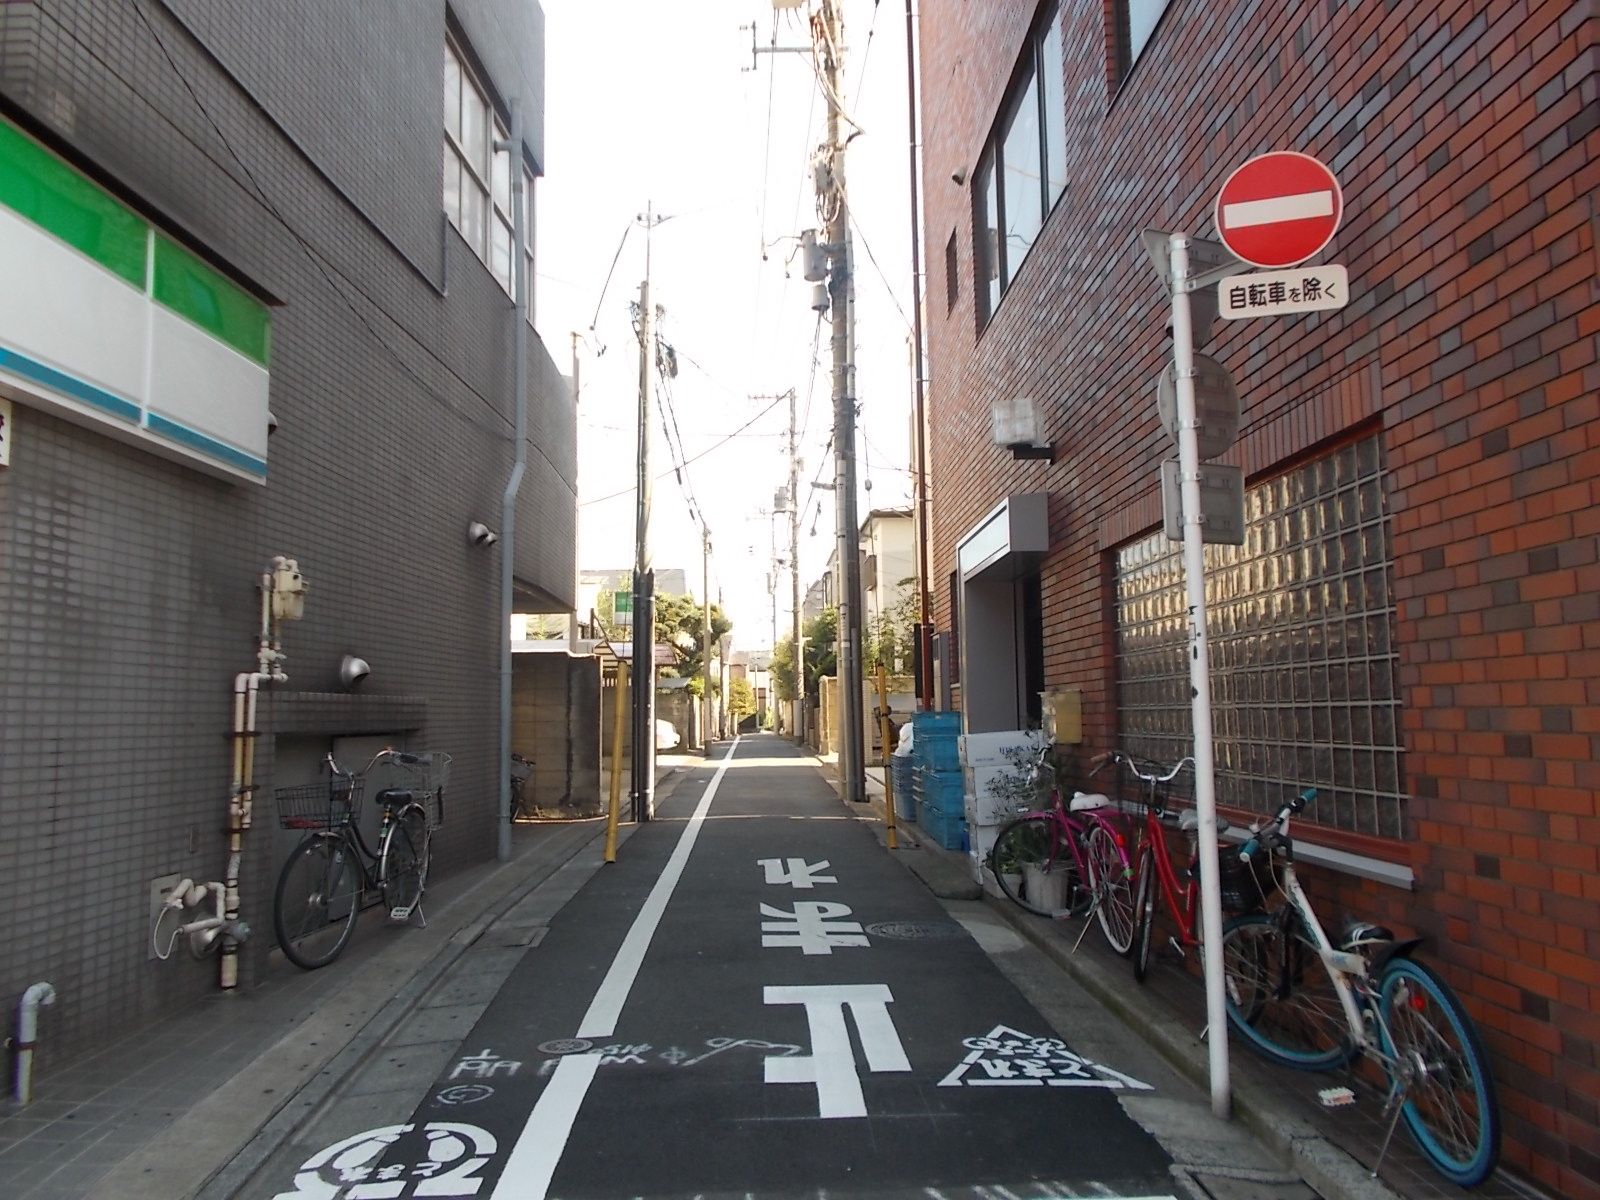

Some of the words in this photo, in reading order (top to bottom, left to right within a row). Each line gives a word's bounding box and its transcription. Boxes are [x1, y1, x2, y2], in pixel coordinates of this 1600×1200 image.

[1230, 278, 1336, 309] 自転車を除く
[757, 857, 913, 1118] 止まれ
[978, 1059, 1091, 1078] とまれ
